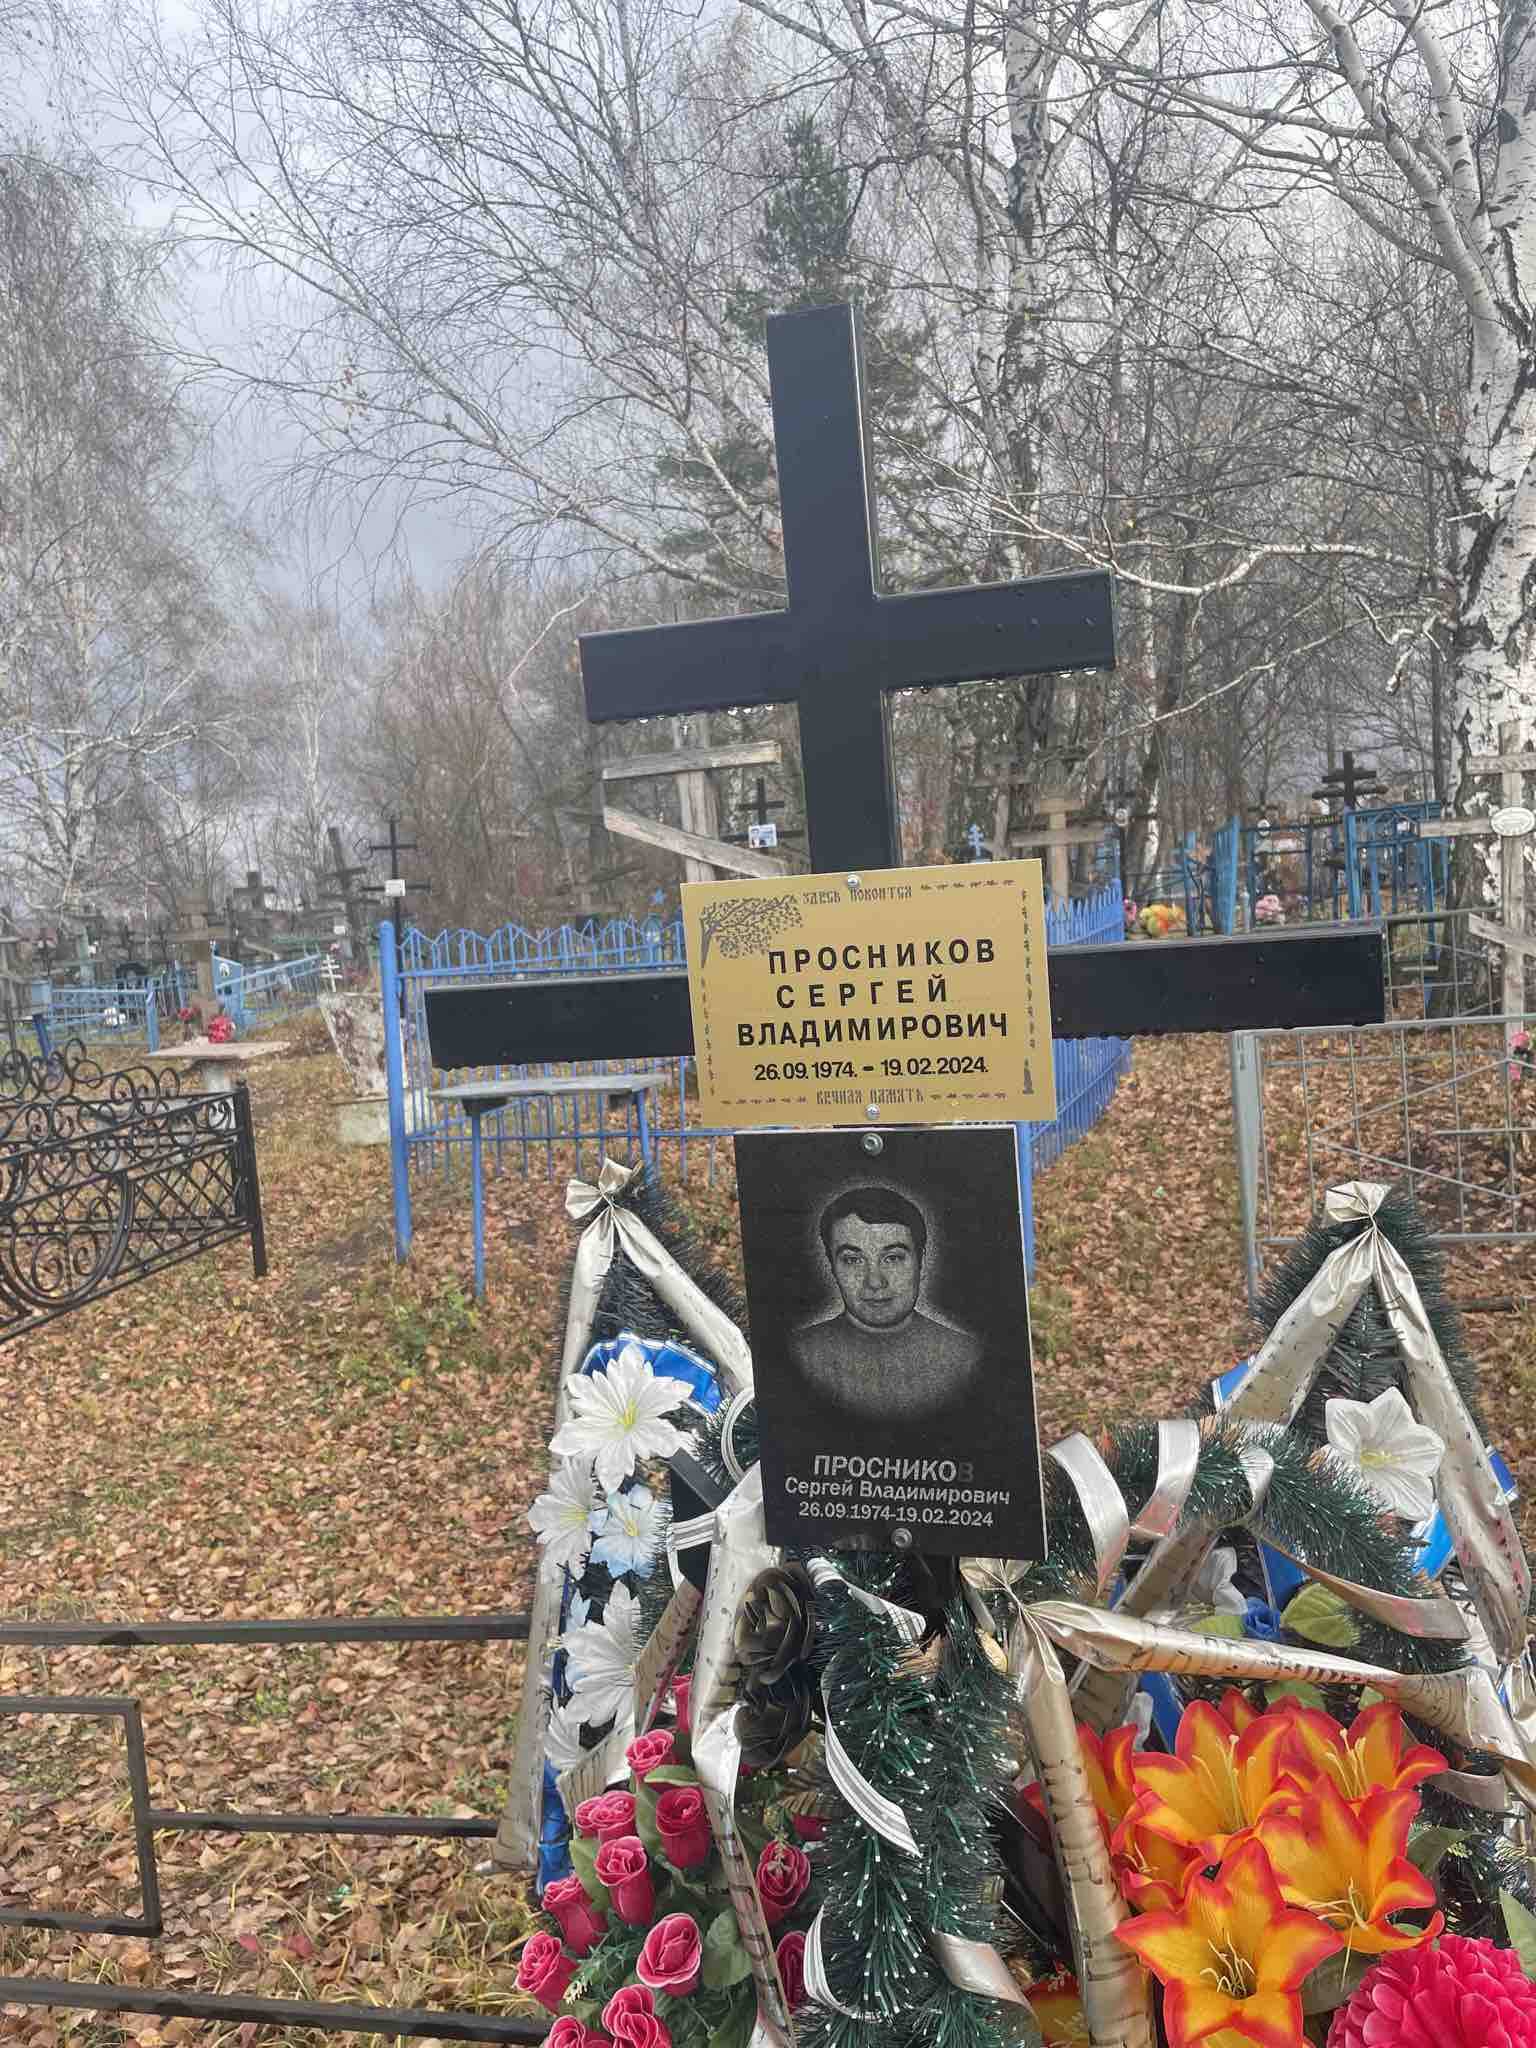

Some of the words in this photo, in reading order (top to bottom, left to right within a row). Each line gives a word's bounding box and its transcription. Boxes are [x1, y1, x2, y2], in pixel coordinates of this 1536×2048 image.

[768, 938, 996, 975] ПРОСНИКОВ
[776, 974, 949, 1009] СЕРГЕЙ
[737, 1012, 1009, 1048] ВЛАДИМИРОВИЧ
[813, 1455, 974, 1483] ПРОСНИКОВ
[784, 1476, 853, 1498] Сергей
[859, 1480, 1010, 1506] Владимирович
[798, 1501, 994, 1527] 26.09.1974-19.02.2024
